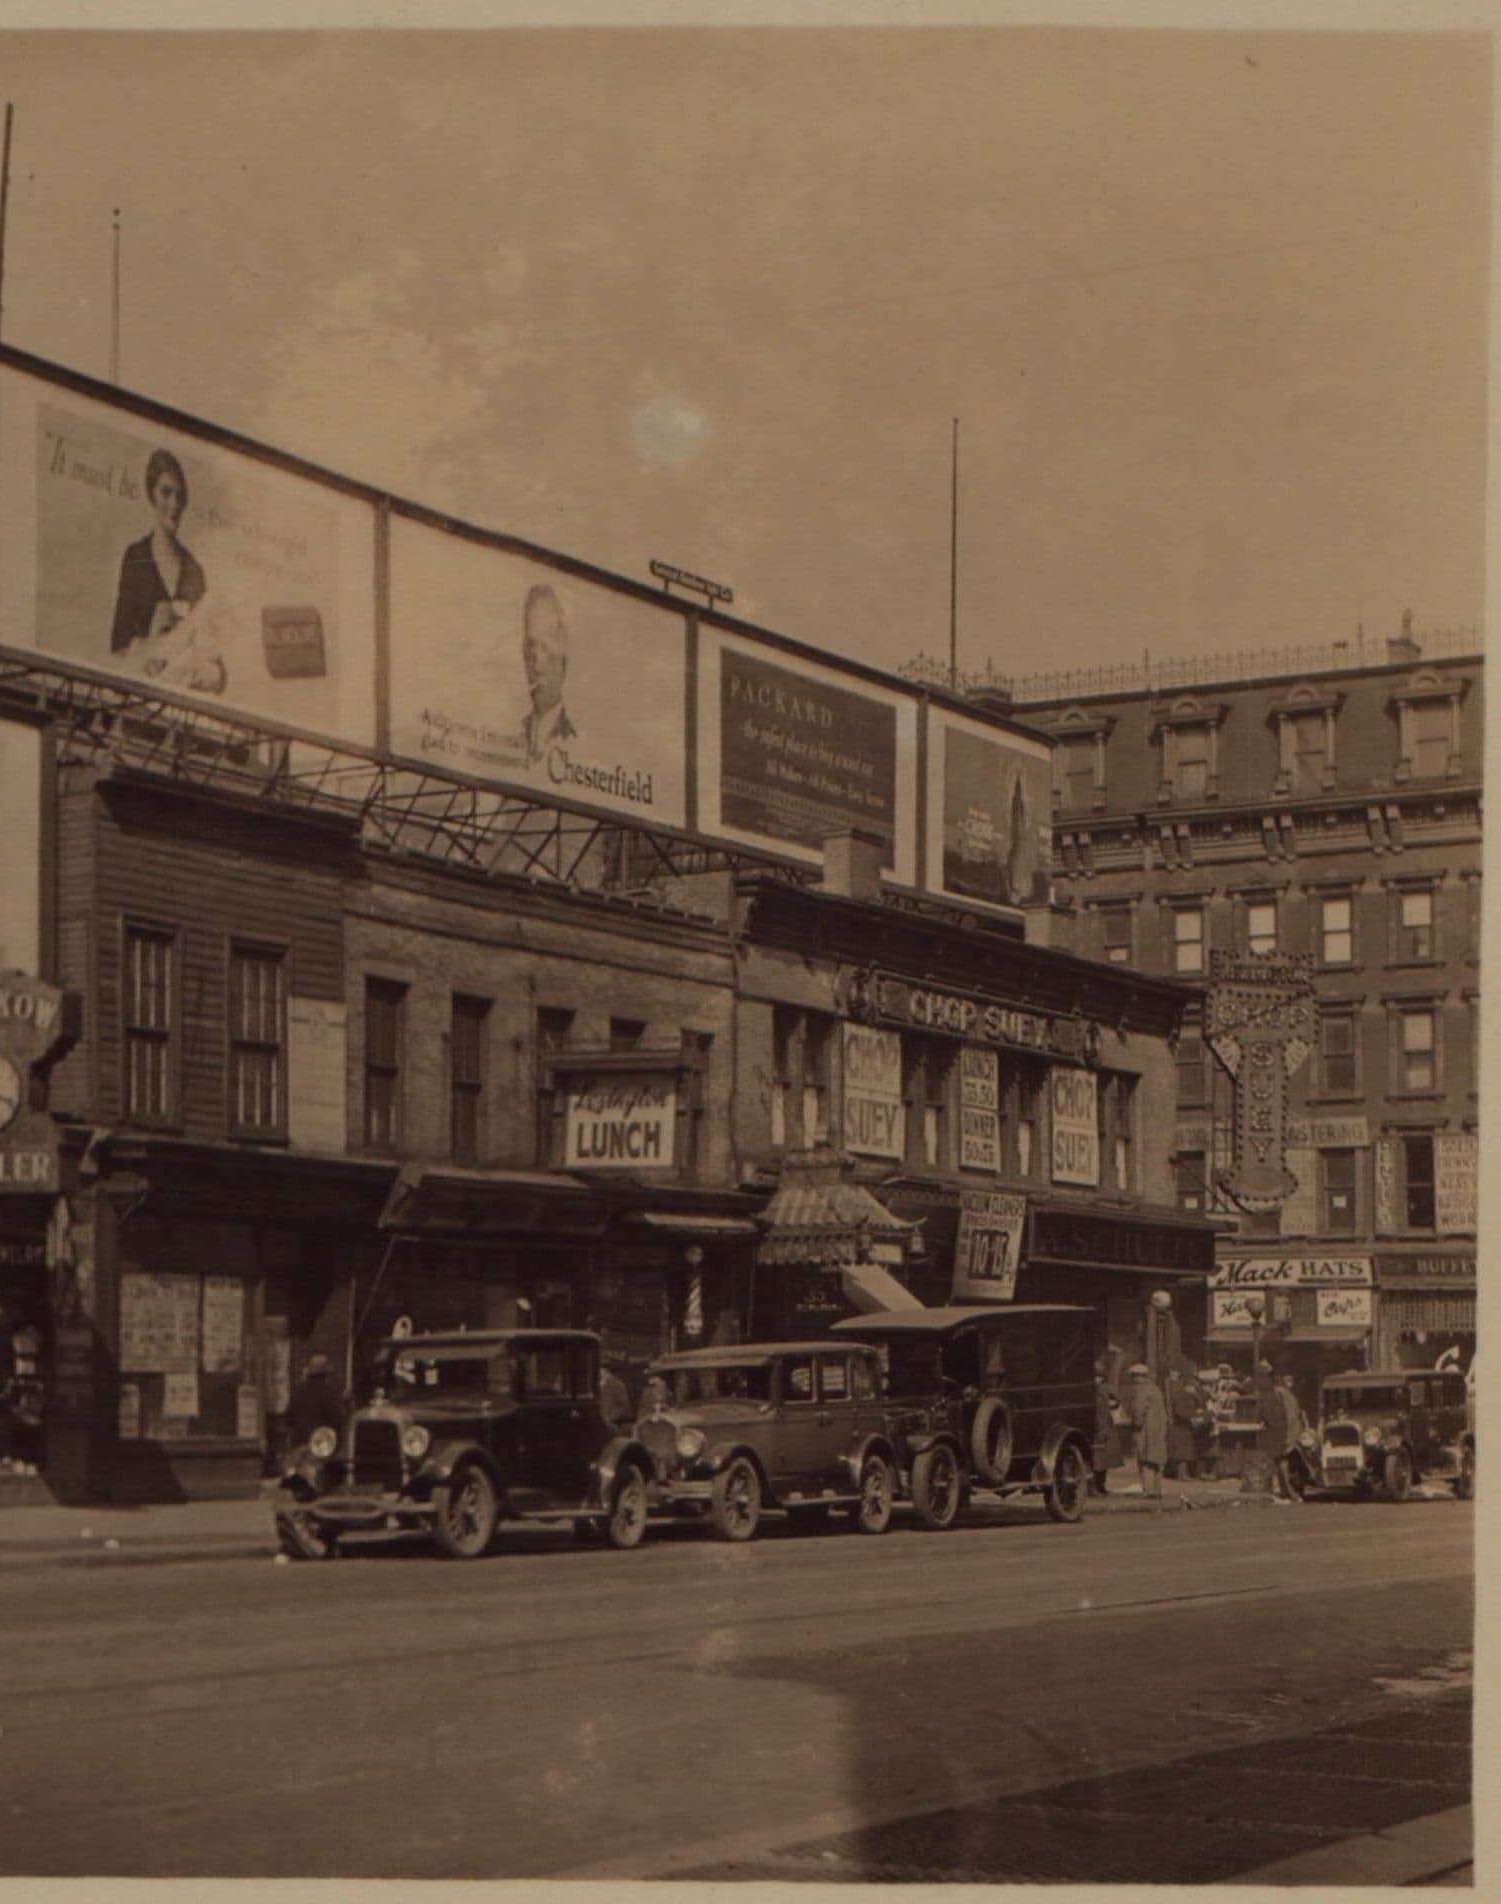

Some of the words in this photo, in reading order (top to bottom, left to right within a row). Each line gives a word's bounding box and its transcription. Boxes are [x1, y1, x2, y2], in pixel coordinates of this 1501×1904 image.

[730, 674, 833, 728] PACKARD
[547, 745, 653, 806] Chesterfield
[910, 988, 978, 1032] CHOP
[983, 1004, 1049, 1049] SUEY
[577, 1121, 660, 1159] LUNCH
[847, 1097, 898, 1150] SUEY
[1212, 1258, 1294, 1287] Mack
[1299, 1260, 1365, 1276] HATS
